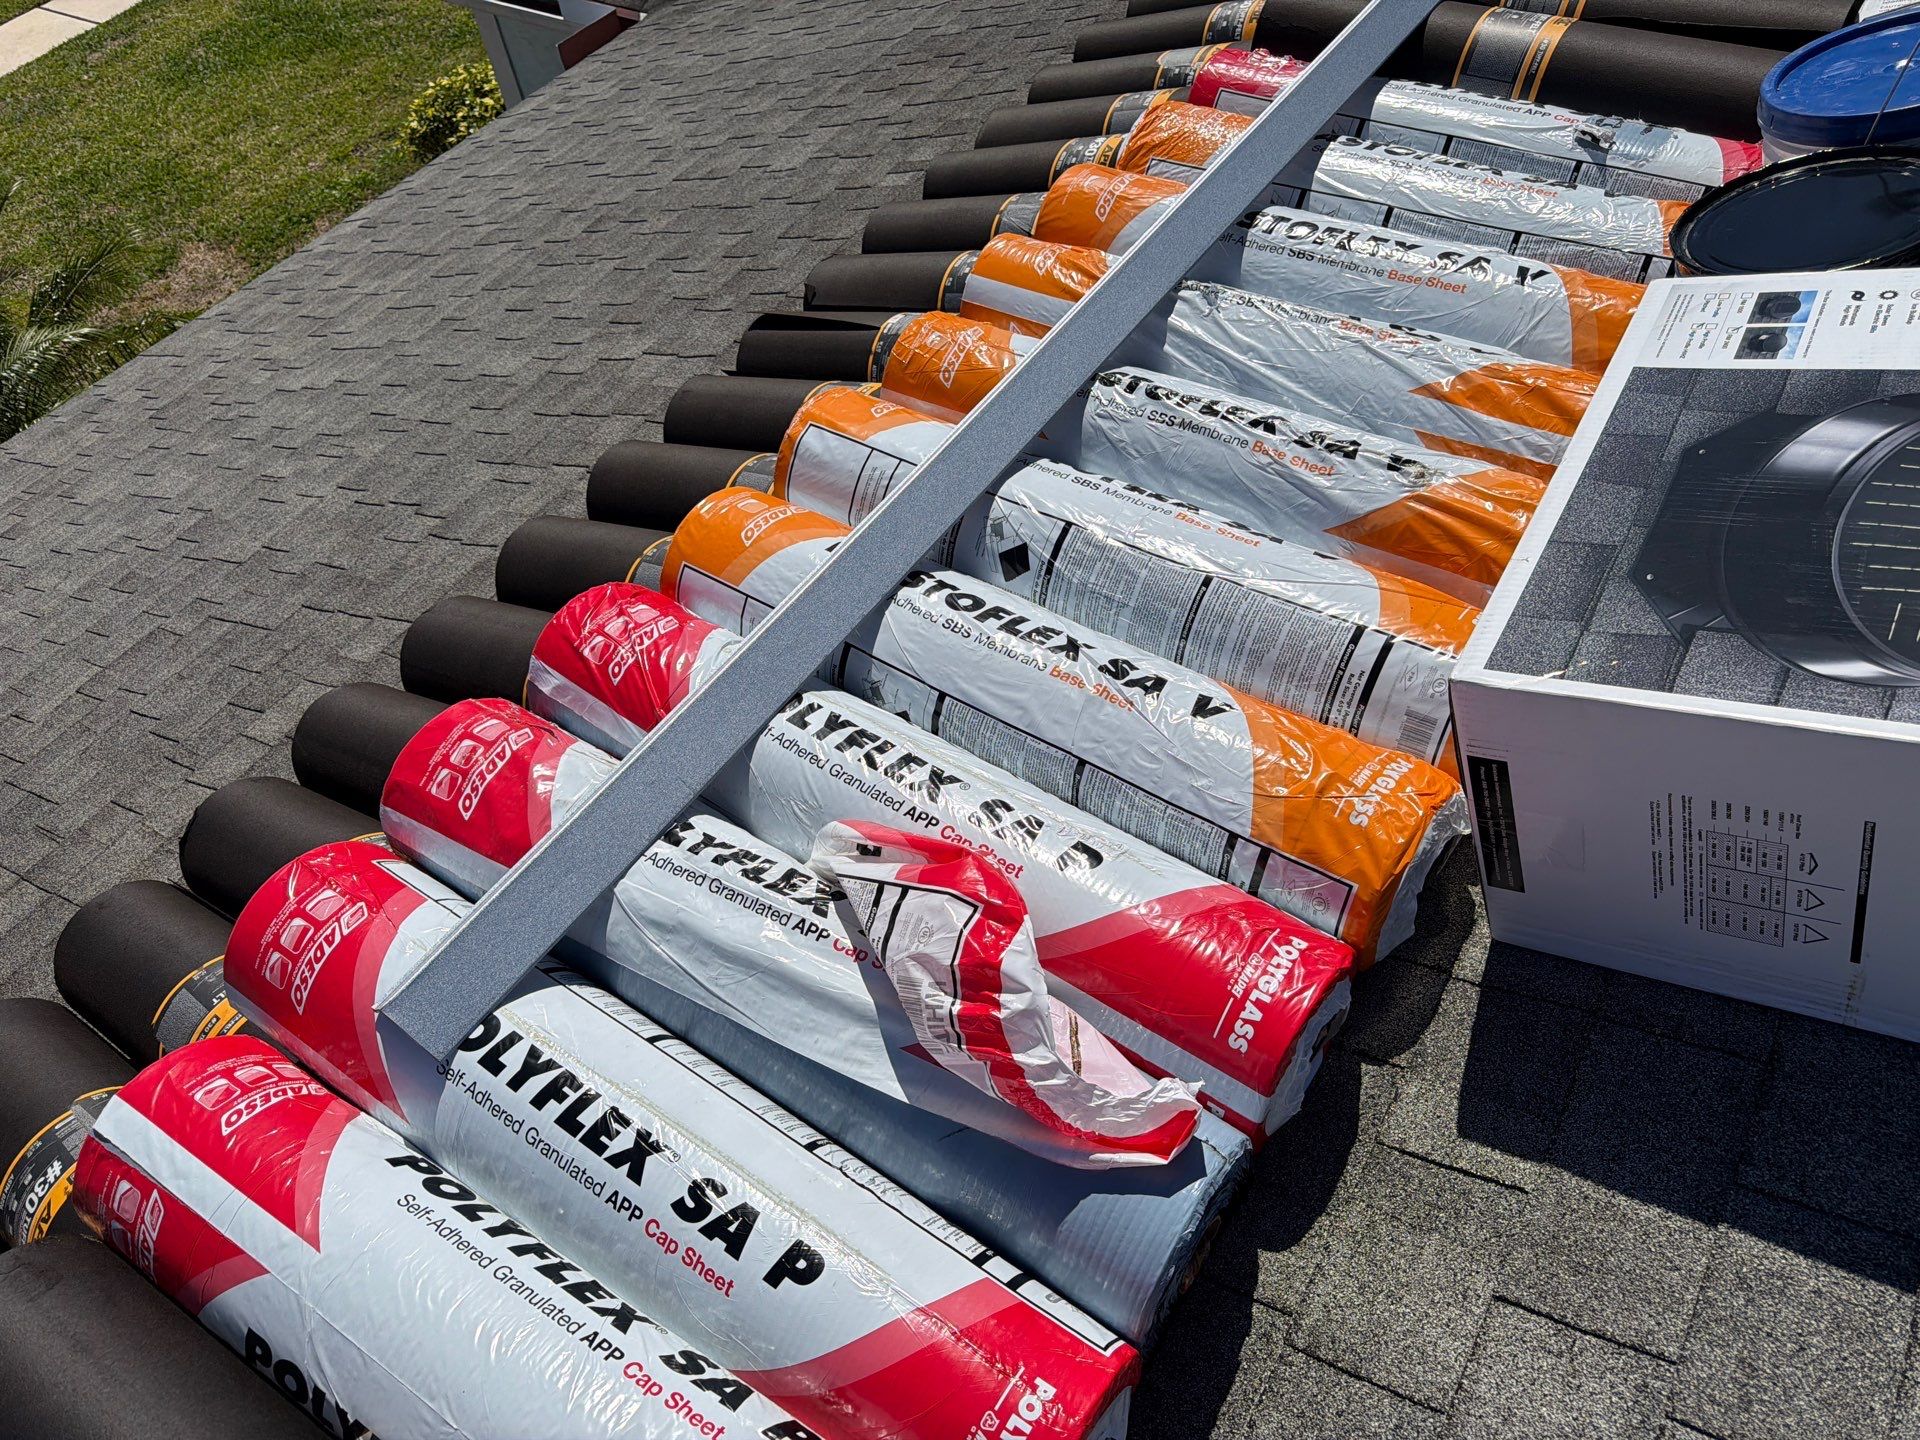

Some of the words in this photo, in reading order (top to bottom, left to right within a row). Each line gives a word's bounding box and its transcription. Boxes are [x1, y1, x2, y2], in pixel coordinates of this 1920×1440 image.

[1458, 96, 1522, 113] Granulated
[1523, 107, 1551, 118] APP
[1287, 248, 1315, 262] SBS
[1317, 254, 1385, 278] Membrane
[1387, 269, 1423, 285] Base
[1425, 276, 1468, 295] Sheet
[1147, 410, 1177, 427] SBS
[1178, 418, 1249, 449] Membrane
[1251, 440, 1287, 461] Base
[1289, 454, 1335, 477] Sheet
[742, 507, 791, 546] ADESO
[1070, 474, 1102, 491] SBS
[1102, 487, 1174, 517] Membrane
[1174, 511, 1214, 532] Base
[1215, 526, 1263, 549] Sheet
[941, 619, 974, 639] SBS
[1049, 664, 1086, 690] Base
[1097, 658, 1168, 699] SA
[1190, 693, 1238, 720] V
[459, 742, 511, 819] ADESO
[828, 762, 906, 813] Granulated
[903, 805, 940, 830] APP
[708, 876, 793, 928] Granulated
[791, 918, 831, 943] APP
[832, 936, 869, 964] Cap
[292, 922, 342, 1015] ADESO
[1227, 935, 1309, 1054] POLYGLASS
[221, 1084, 308, 1135] ADESO
[24, 1158, 63, 1215] #30
[436, 1057, 526, 1136] Self-Adhered
[524, 1127, 608, 1199] Granulated
[604, 1189, 645, 1223] APP
[643, 1217, 680, 1257] Cap
[680, 1246, 736, 1299] Sheet
[669, 1177, 761, 1262] SA
[762, 1238, 825, 1290] P
[396, 1193, 498, 1271] Self-Adhered
[492, 1263, 587, 1337] Granulated
[579, 1329, 626, 1363] APP
[622, 1360, 664, 1398] Cap
[663, 1390, 728, 1440] Sheet
[658, 1349, 756, 1414] SA
